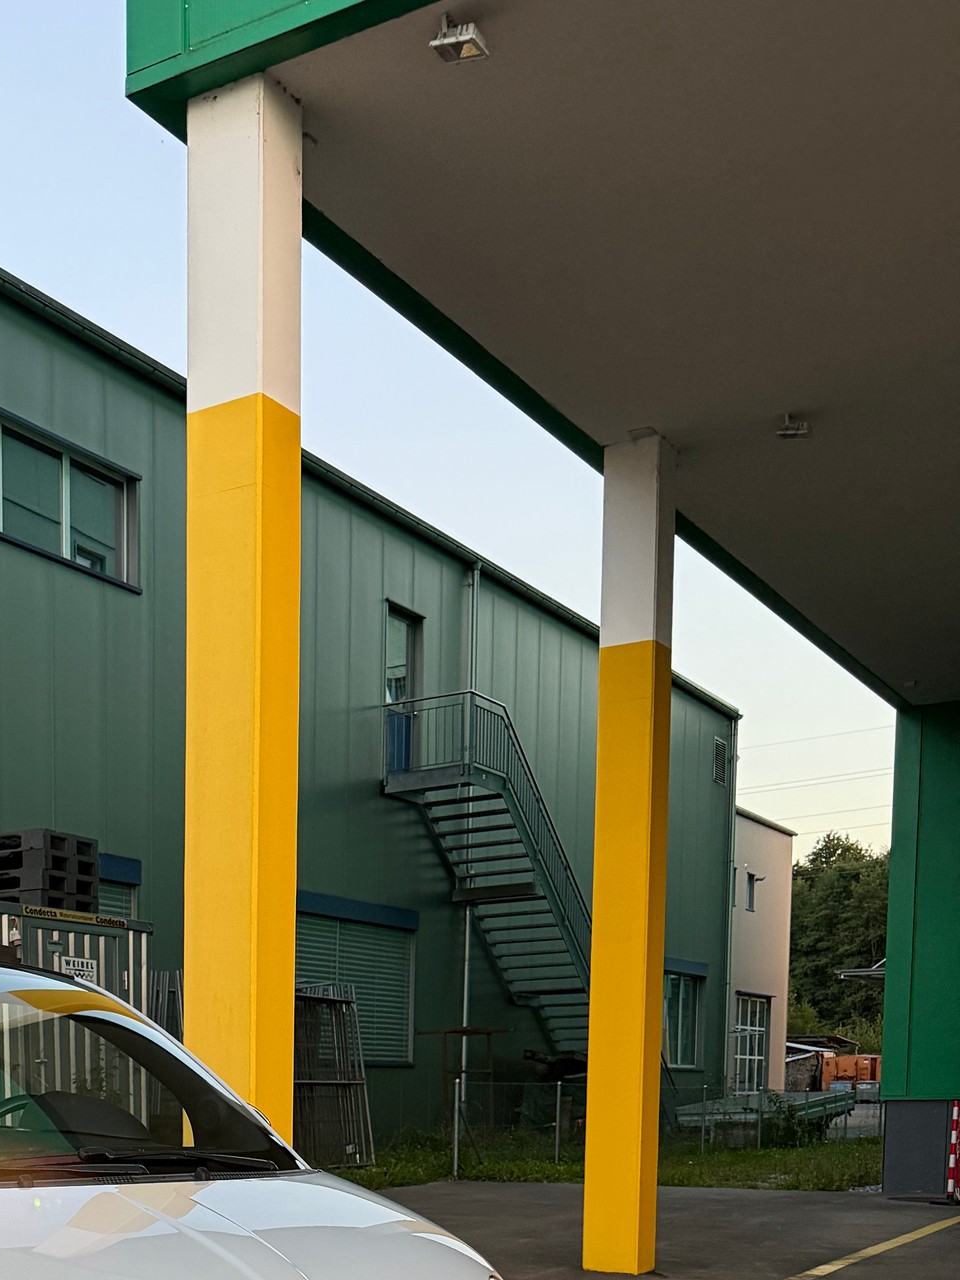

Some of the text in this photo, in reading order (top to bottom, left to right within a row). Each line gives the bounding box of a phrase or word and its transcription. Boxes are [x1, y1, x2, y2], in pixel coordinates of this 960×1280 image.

[25, 906, 57, 918] Condecta
[95, 916, 125, 927] Condecta
[64, 959, 94, 970] WEIBEL
